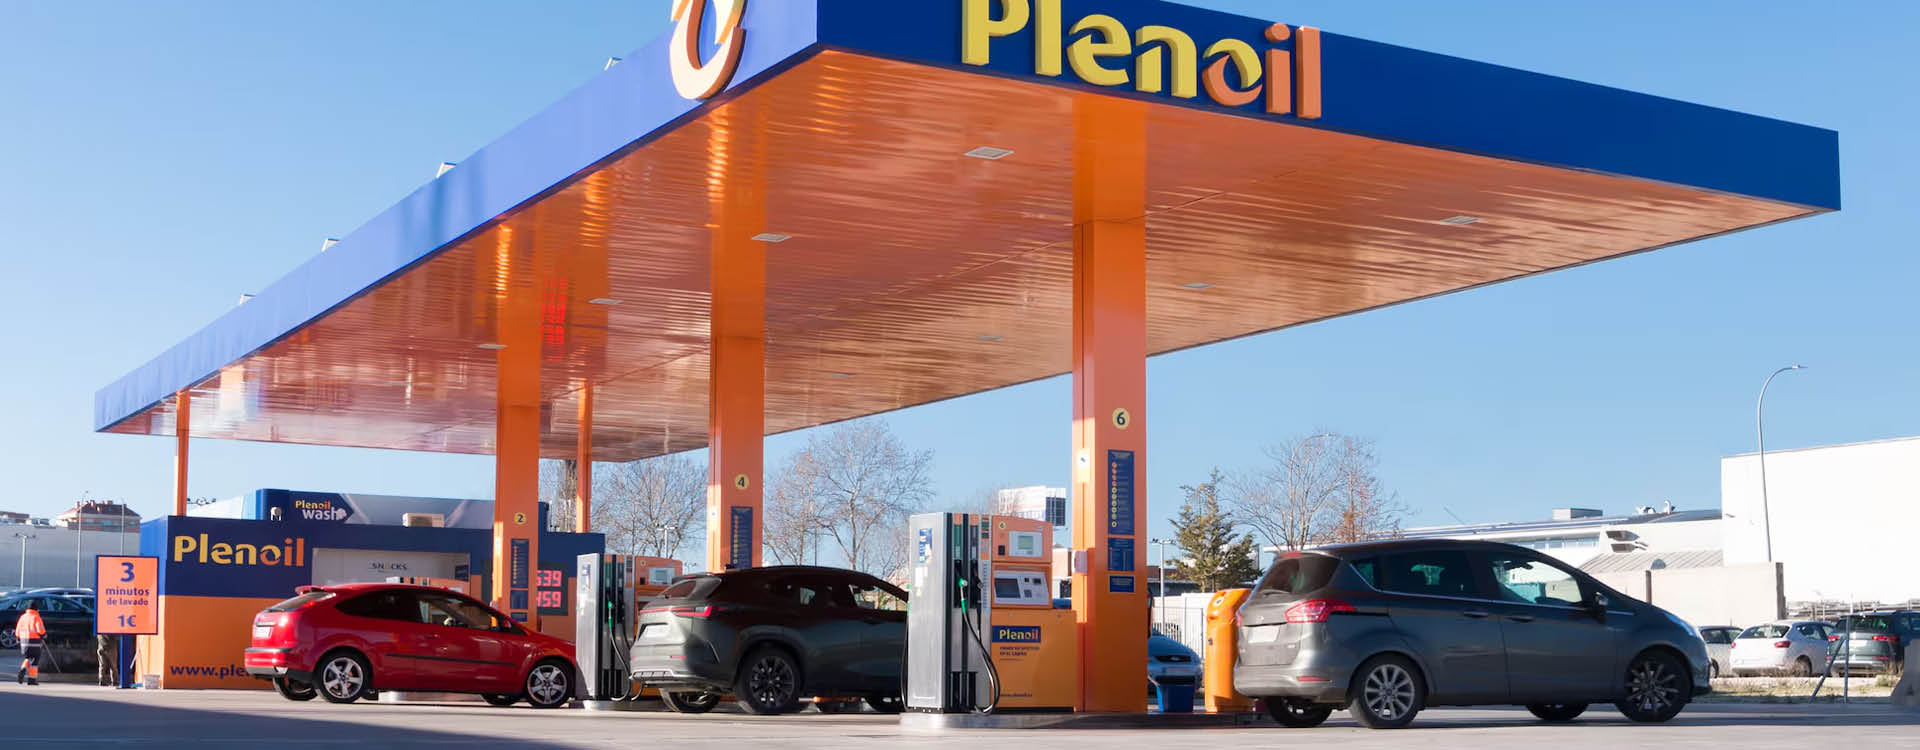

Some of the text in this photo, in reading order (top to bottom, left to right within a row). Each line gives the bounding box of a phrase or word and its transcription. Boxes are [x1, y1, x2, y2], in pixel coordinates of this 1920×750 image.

[961, 0, 1322, 119] Plenoil
[1116, 411, 1126, 425] 6
[295, 500, 331, 510] Plenoil
[302, 507, 340, 520] wash
[173, 533, 305, 567] Plenoil
[120, 562, 135, 582] 3
[105, 587, 150, 596] minutos
[120, 598, 149, 606] lavado
[118, 614, 137, 627] 1€
[1000, 628, 1039, 640] Plenoil
[170, 664, 249, 679] www.ple
